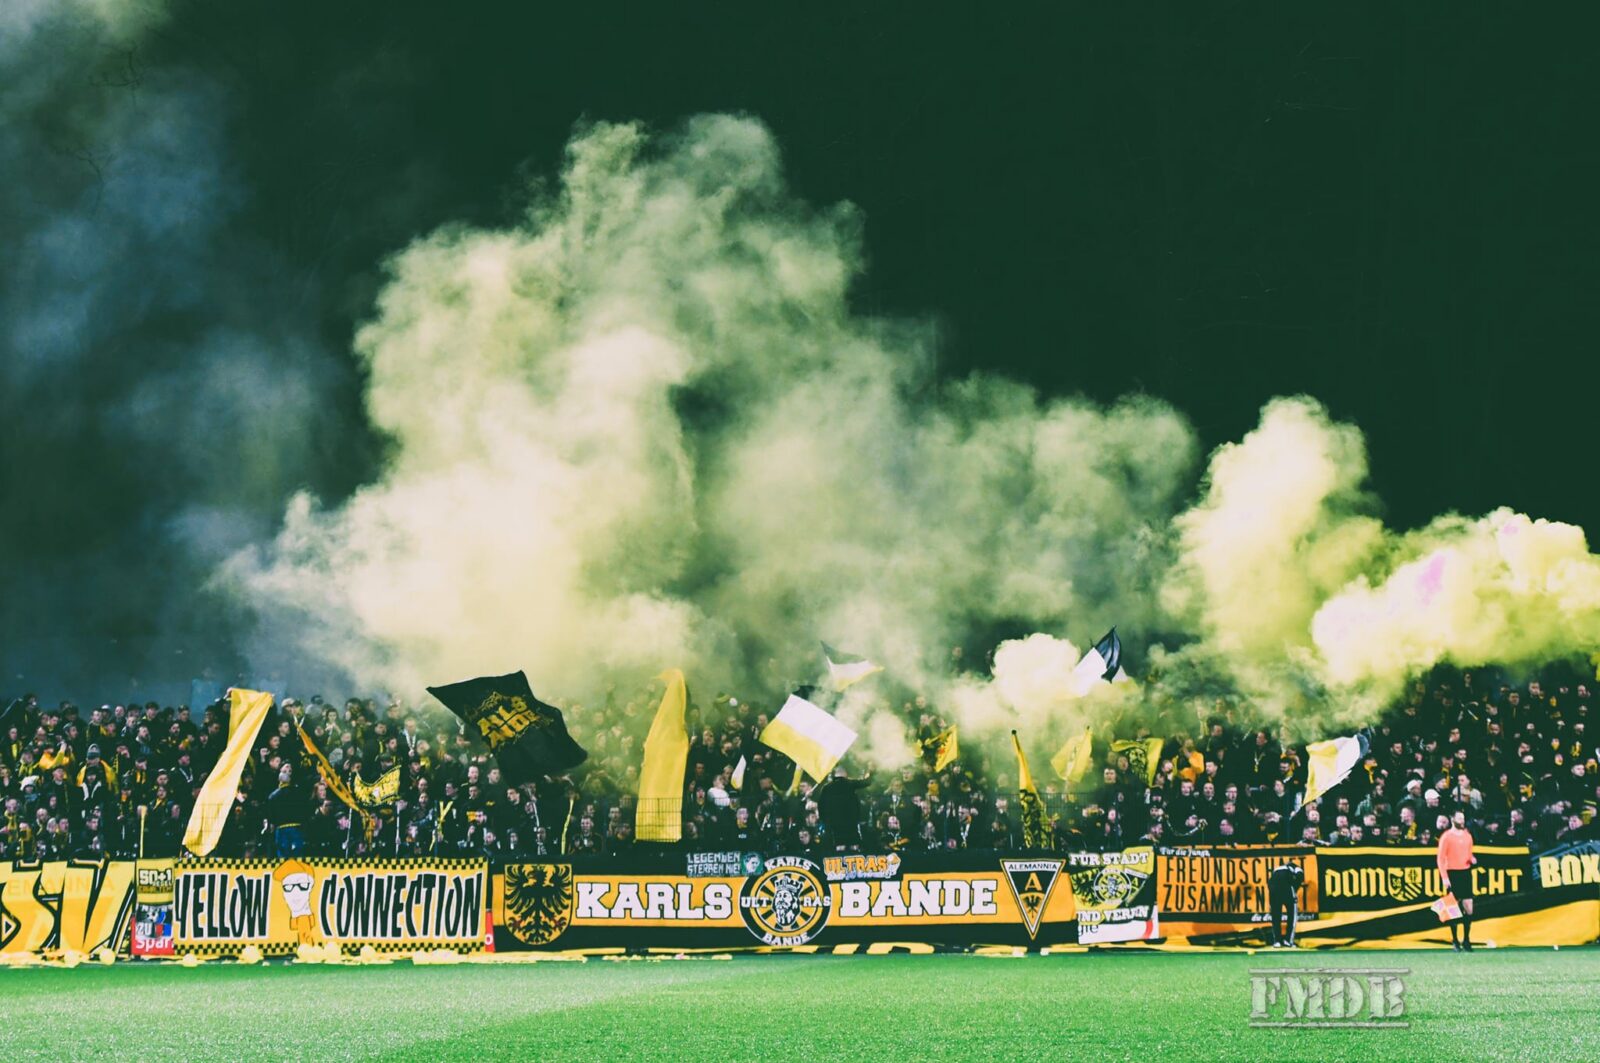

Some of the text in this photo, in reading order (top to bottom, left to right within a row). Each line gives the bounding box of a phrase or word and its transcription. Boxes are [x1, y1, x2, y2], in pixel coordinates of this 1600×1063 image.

[824, 856, 887, 874] ULTRAS
[1069, 851, 1149, 866] FÜR STADT
[139, 869, 172, 886] 50+1
[1024, 872, 1043, 891] A
[1425, 868, 1522, 897] WCHT
[174, 872, 482, 939] YELLOW CONNECTION
[576, 879, 997, 919] KARLS BANDE
[136, 937, 173, 952] Spar
[762, 932, 811, 946] BANDE
